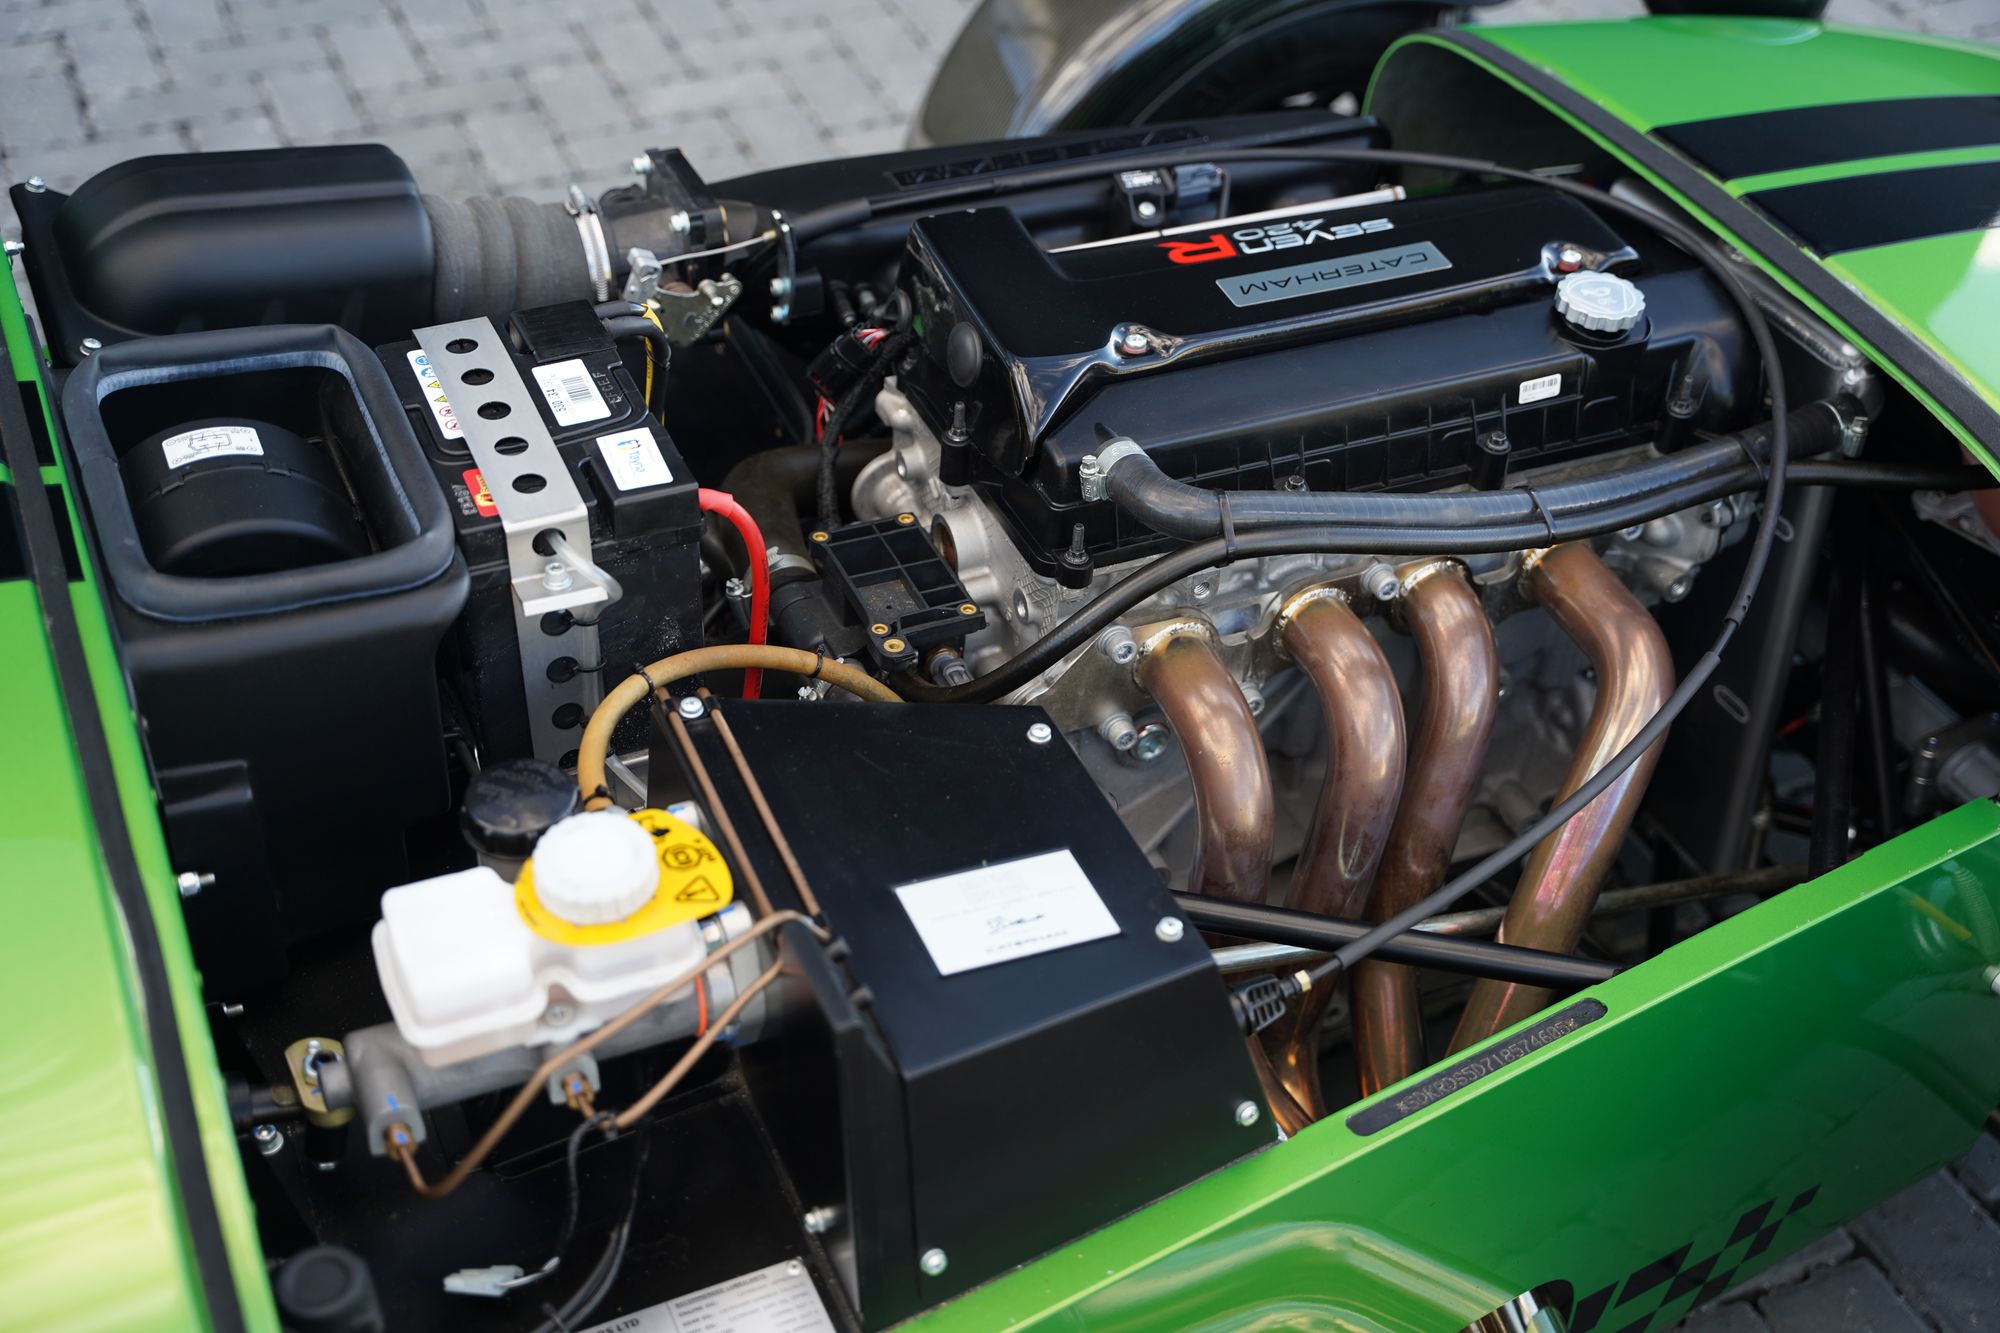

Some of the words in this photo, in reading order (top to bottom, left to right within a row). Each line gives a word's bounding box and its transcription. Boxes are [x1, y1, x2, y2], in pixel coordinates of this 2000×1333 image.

[1232, 217, 1327, 240] 420
[1241, 217, 1395, 255] SEVEN
[1156, 233, 1238, 264] R
[1238, 251, 1430, 296] CATERHAM
[629, 450, 646, 473] Tayna
